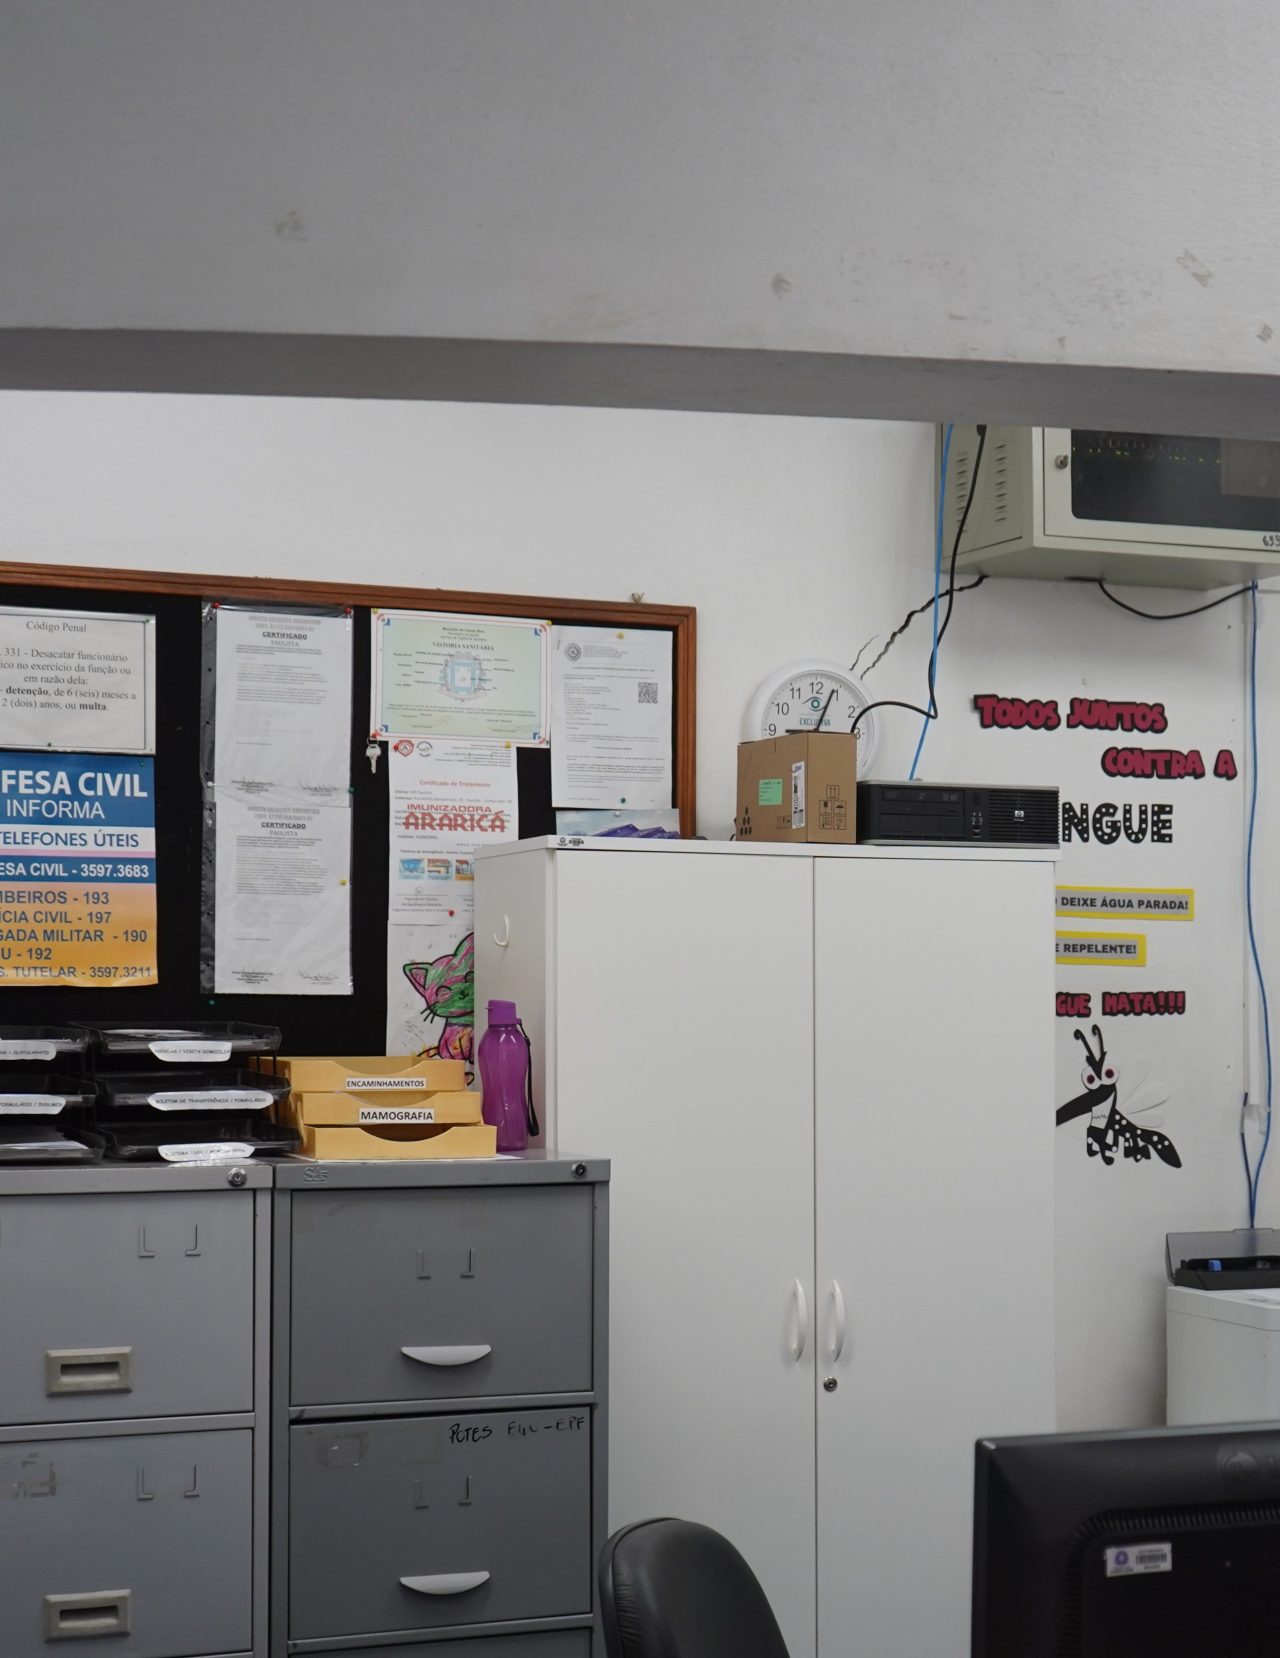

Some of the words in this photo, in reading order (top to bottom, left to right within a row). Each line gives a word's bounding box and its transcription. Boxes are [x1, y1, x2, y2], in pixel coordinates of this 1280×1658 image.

[26, 620, 60, 632] Código
[62, 622, 87, 632] Penal
[262, 631, 308, 640] CERTIFICADO
[432, 641, 461, 649] VISTORIA
[5, 647, 21, 657] 331
[31, 648, 74, 659] Desacatar
[77, 651, 128, 662] funcionário
[17, 662, 28, 670] no
[31, 661, 72, 672] exercício
[74, 664, 85, 672] da
[88, 664, 118, 675] função
[40, 675, 65, 684] razão
[67, 676, 88, 685] dela:
[6, 686, 51, 697] detenção,
[54, 687, 65, 696] de
[67, 688, 73, 697] 6
[75, 690, 99, 699] (seis)
[101, 691, 129, 700] meses
[789, 685, 801, 699] 11
[809, 681, 824, 694] 12
[834, 689, 839, 701] 1
[2, 698, 8, 707] 2
[10, 700, 37, 709] (dois)
[39, 701, 62, 710] anos,
[775, 702, 790, 716] 10
[848, 705, 856, 718] 2
[973, 694, 1061, 731] TODOS
[1067, 697, 1168, 733] JUNTOS
[768, 723, 776, 737] 9
[1101, 747, 1205, 779] CONTRA
[1214, 750, 1237, 780] A
[1, 770, 72, 795] FESA
[78, 771, 148, 797] CIVIL
[6, 799, 106, 819] INFORMA
[407, 803, 492, 813] IMUNIZADORA
[261, 821, 306, 830] CERTIFICADO
[404, 810, 506, 832] ARARICÁ
[1062, 802, 1174, 845] NGUE
[0, 831, 87, 847] ELEFONES
[94, 829, 139, 848] ÚTEIS
[30, 862, 68, 877] CIVIL
[81, 864, 149, 878] 3597.3683
[0, 891, 67, 904] BEIROS
[83, 892, 110, 905] 193
[1061, 897, 1097, 908] DEIXE
[1100, 896, 1134, 909] ÁGUA
[1137, 899, 1189, 910] PARADA!
[33, 911, 72, 923] CIVIL
[87, 912, 112, 924] 197
[43, 930, 104, 942] MILITAR
[122, 930, 147, 942] 190
[26, 948, 52, 960] 192
[1063, 943, 1137, 954] REPELENTE!
[13, 966, 77, 977] TUTELAR
[89, 966, 151, 978] 3597.3211
[1056, 991, 1091, 1018] GUE
[1102, 991, 1186, 1016] MATA!!!
[346, 1080, 425, 1088] ENCAMINHAMENTOS
[361, 1111, 433, 1121] MAMOGRAFIA
[449, 1423, 493, 1444] POTES
